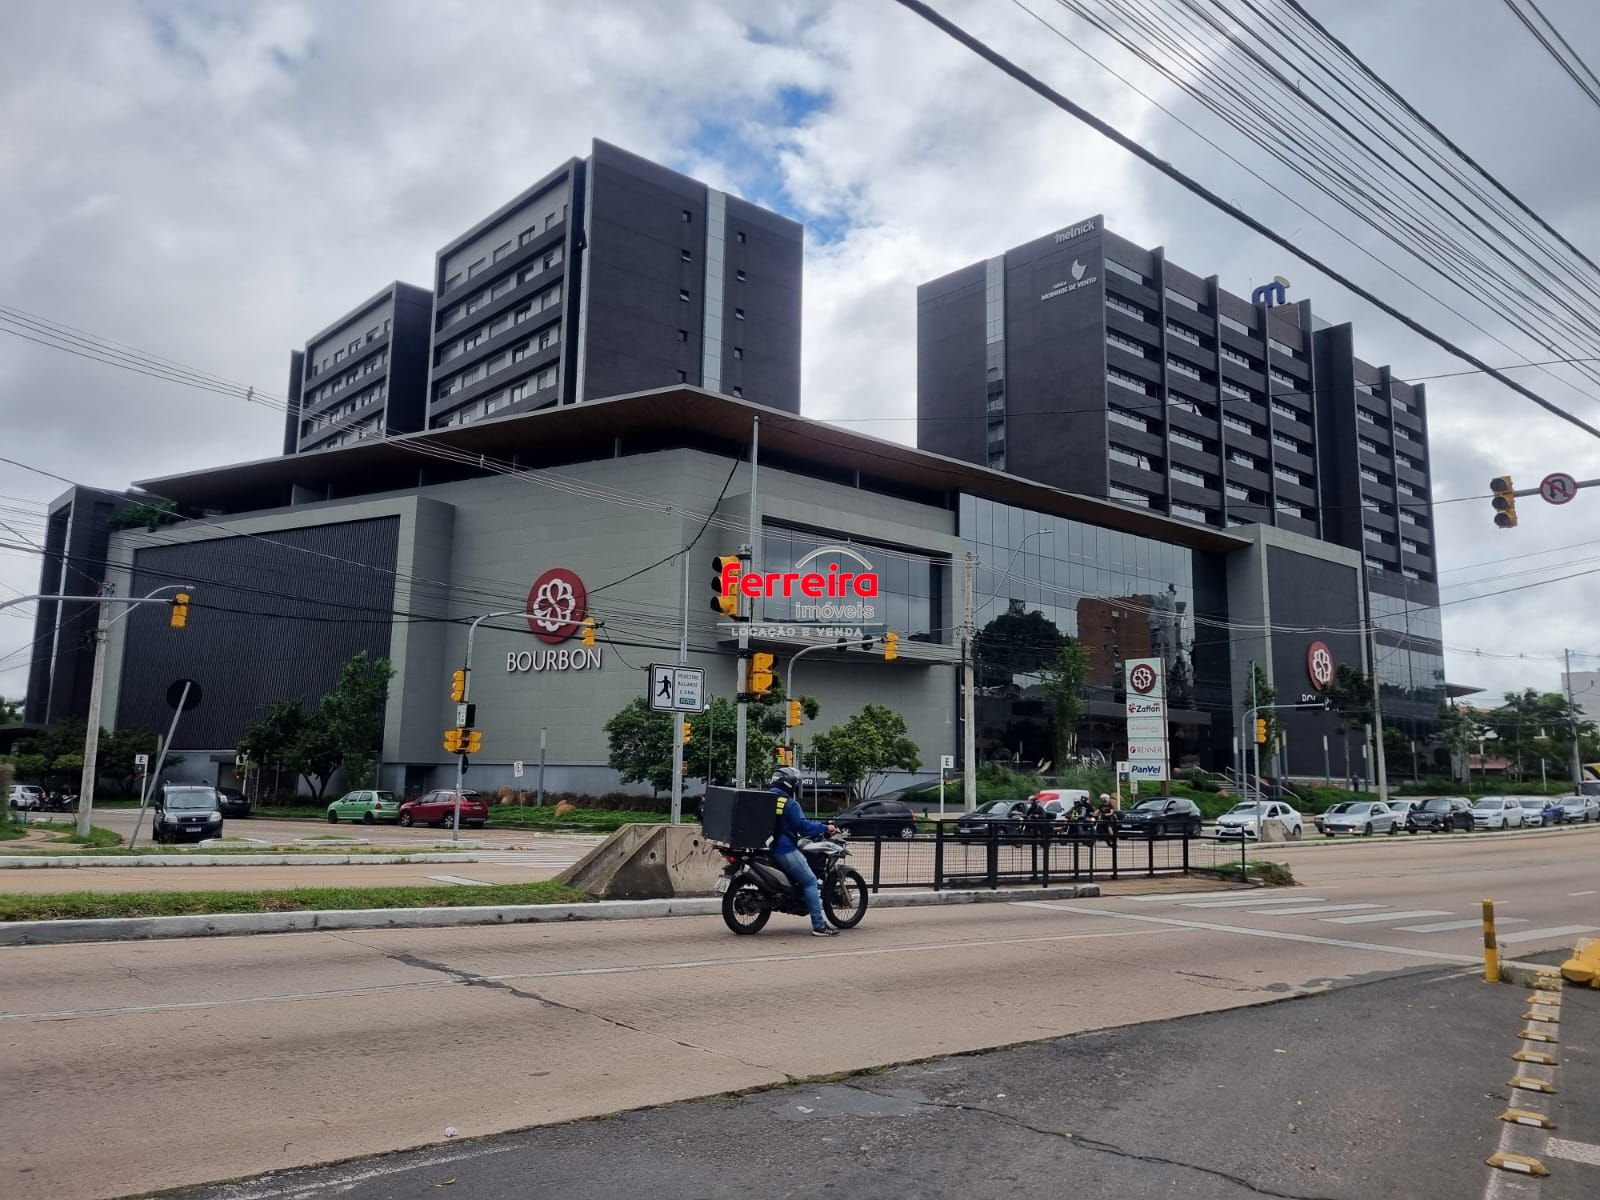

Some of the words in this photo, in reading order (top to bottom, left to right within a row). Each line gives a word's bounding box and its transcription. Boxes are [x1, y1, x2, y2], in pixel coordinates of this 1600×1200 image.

[1054, 220, 1095, 243] melnick
[1068, 283, 1077, 291] DE
[506, 648, 602, 672] BOURBON
